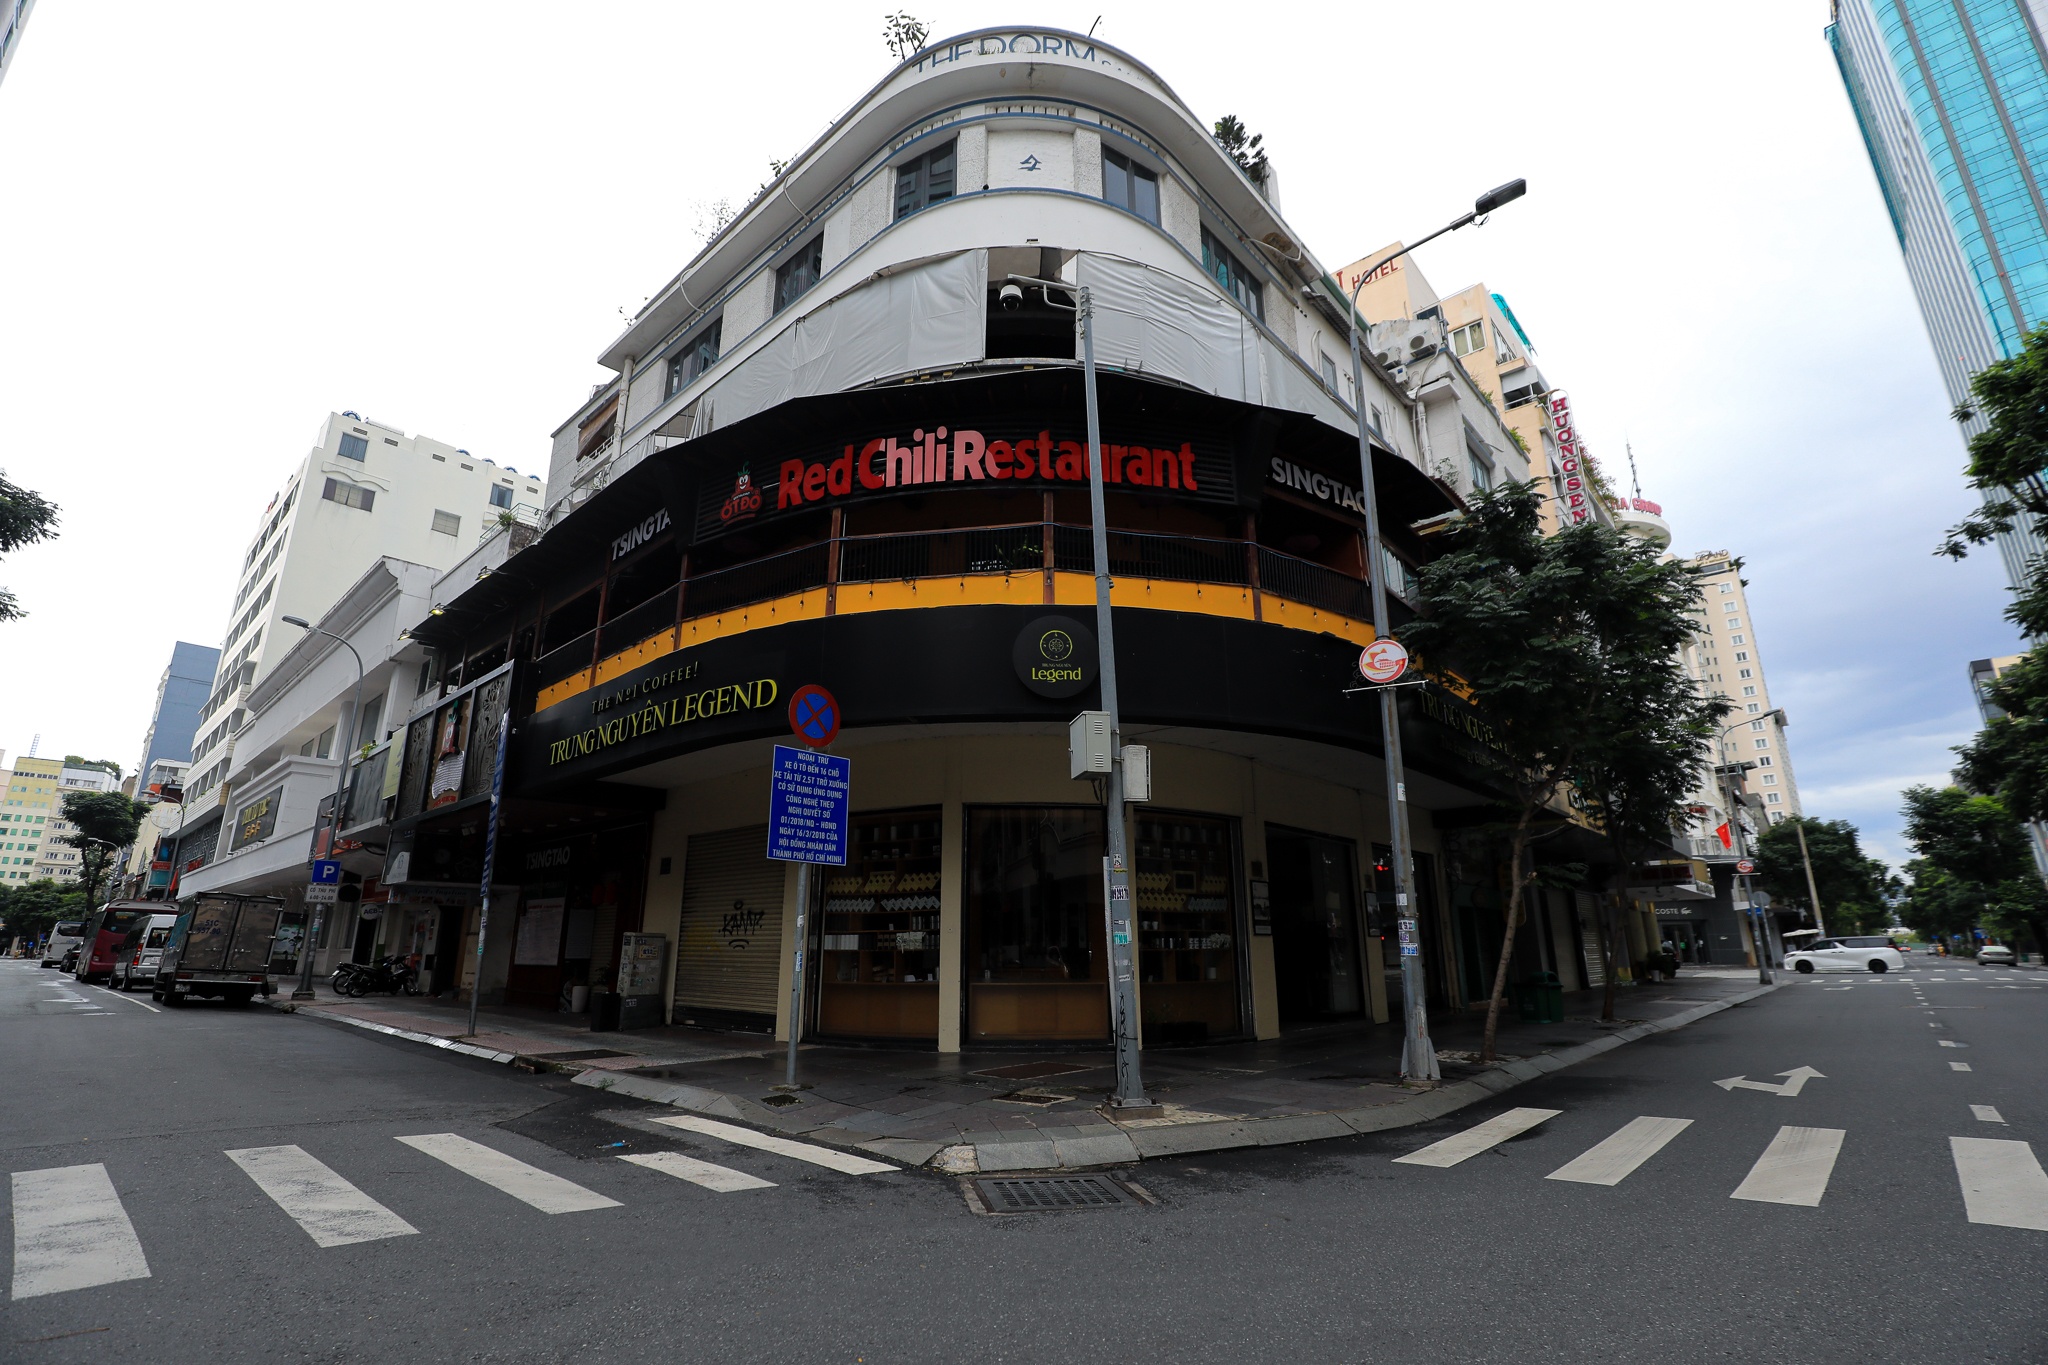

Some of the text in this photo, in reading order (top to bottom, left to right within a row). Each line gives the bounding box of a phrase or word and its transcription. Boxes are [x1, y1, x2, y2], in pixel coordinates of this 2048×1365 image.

[977, 33, 1096, 63] DORM
[777, 425, 1198, 510] Red Chili Restaurant
[1566, 477, 1587, 524] SEN
[1031, 667, 1082, 683] Legend
[591, 695, 611, 715] THE
[642, 661, 699, 694] COFFEE!
[549, 678, 778, 766] TRUNG NGUYÊN LEGEND
[797, 752, 815, 763] NGOẠI
[774, 770, 782, 778] XE
[783, 770, 793, 780] TẢI
[784, 760, 792, 769] XE
[799, 762, 807, 772] TÔ
[820, 767, 827, 775] 16
[778, 781, 787, 790] CÓ
[796, 785, 813, 796] DỤNG
[826, 790, 843, 800] DỤNG
[785, 794, 835, 809] CÔNG NGHỆ THEO
[787, 806, 802, 817] NGHỊ
[779, 825, 795, 836] NGÀY
[796, 828, 826, 839] 16/3/2018
[778, 837, 789, 848] HỘI
[806, 840, 823, 851] NHÂN
[824, 842, 837, 852] DÂN
[525, 845, 571, 871] TSINGTAO
[772, 847, 792, 858] THÀNH
[793, 850, 805, 860] PHỐ
[815, 852, 826, 862] CHÍ
[826, 855, 842, 863] MINH
[322, 865, 336, 879] P
[1655, 907, 1679, 915] COSTE
[204, 919, 220, 927] 51C
